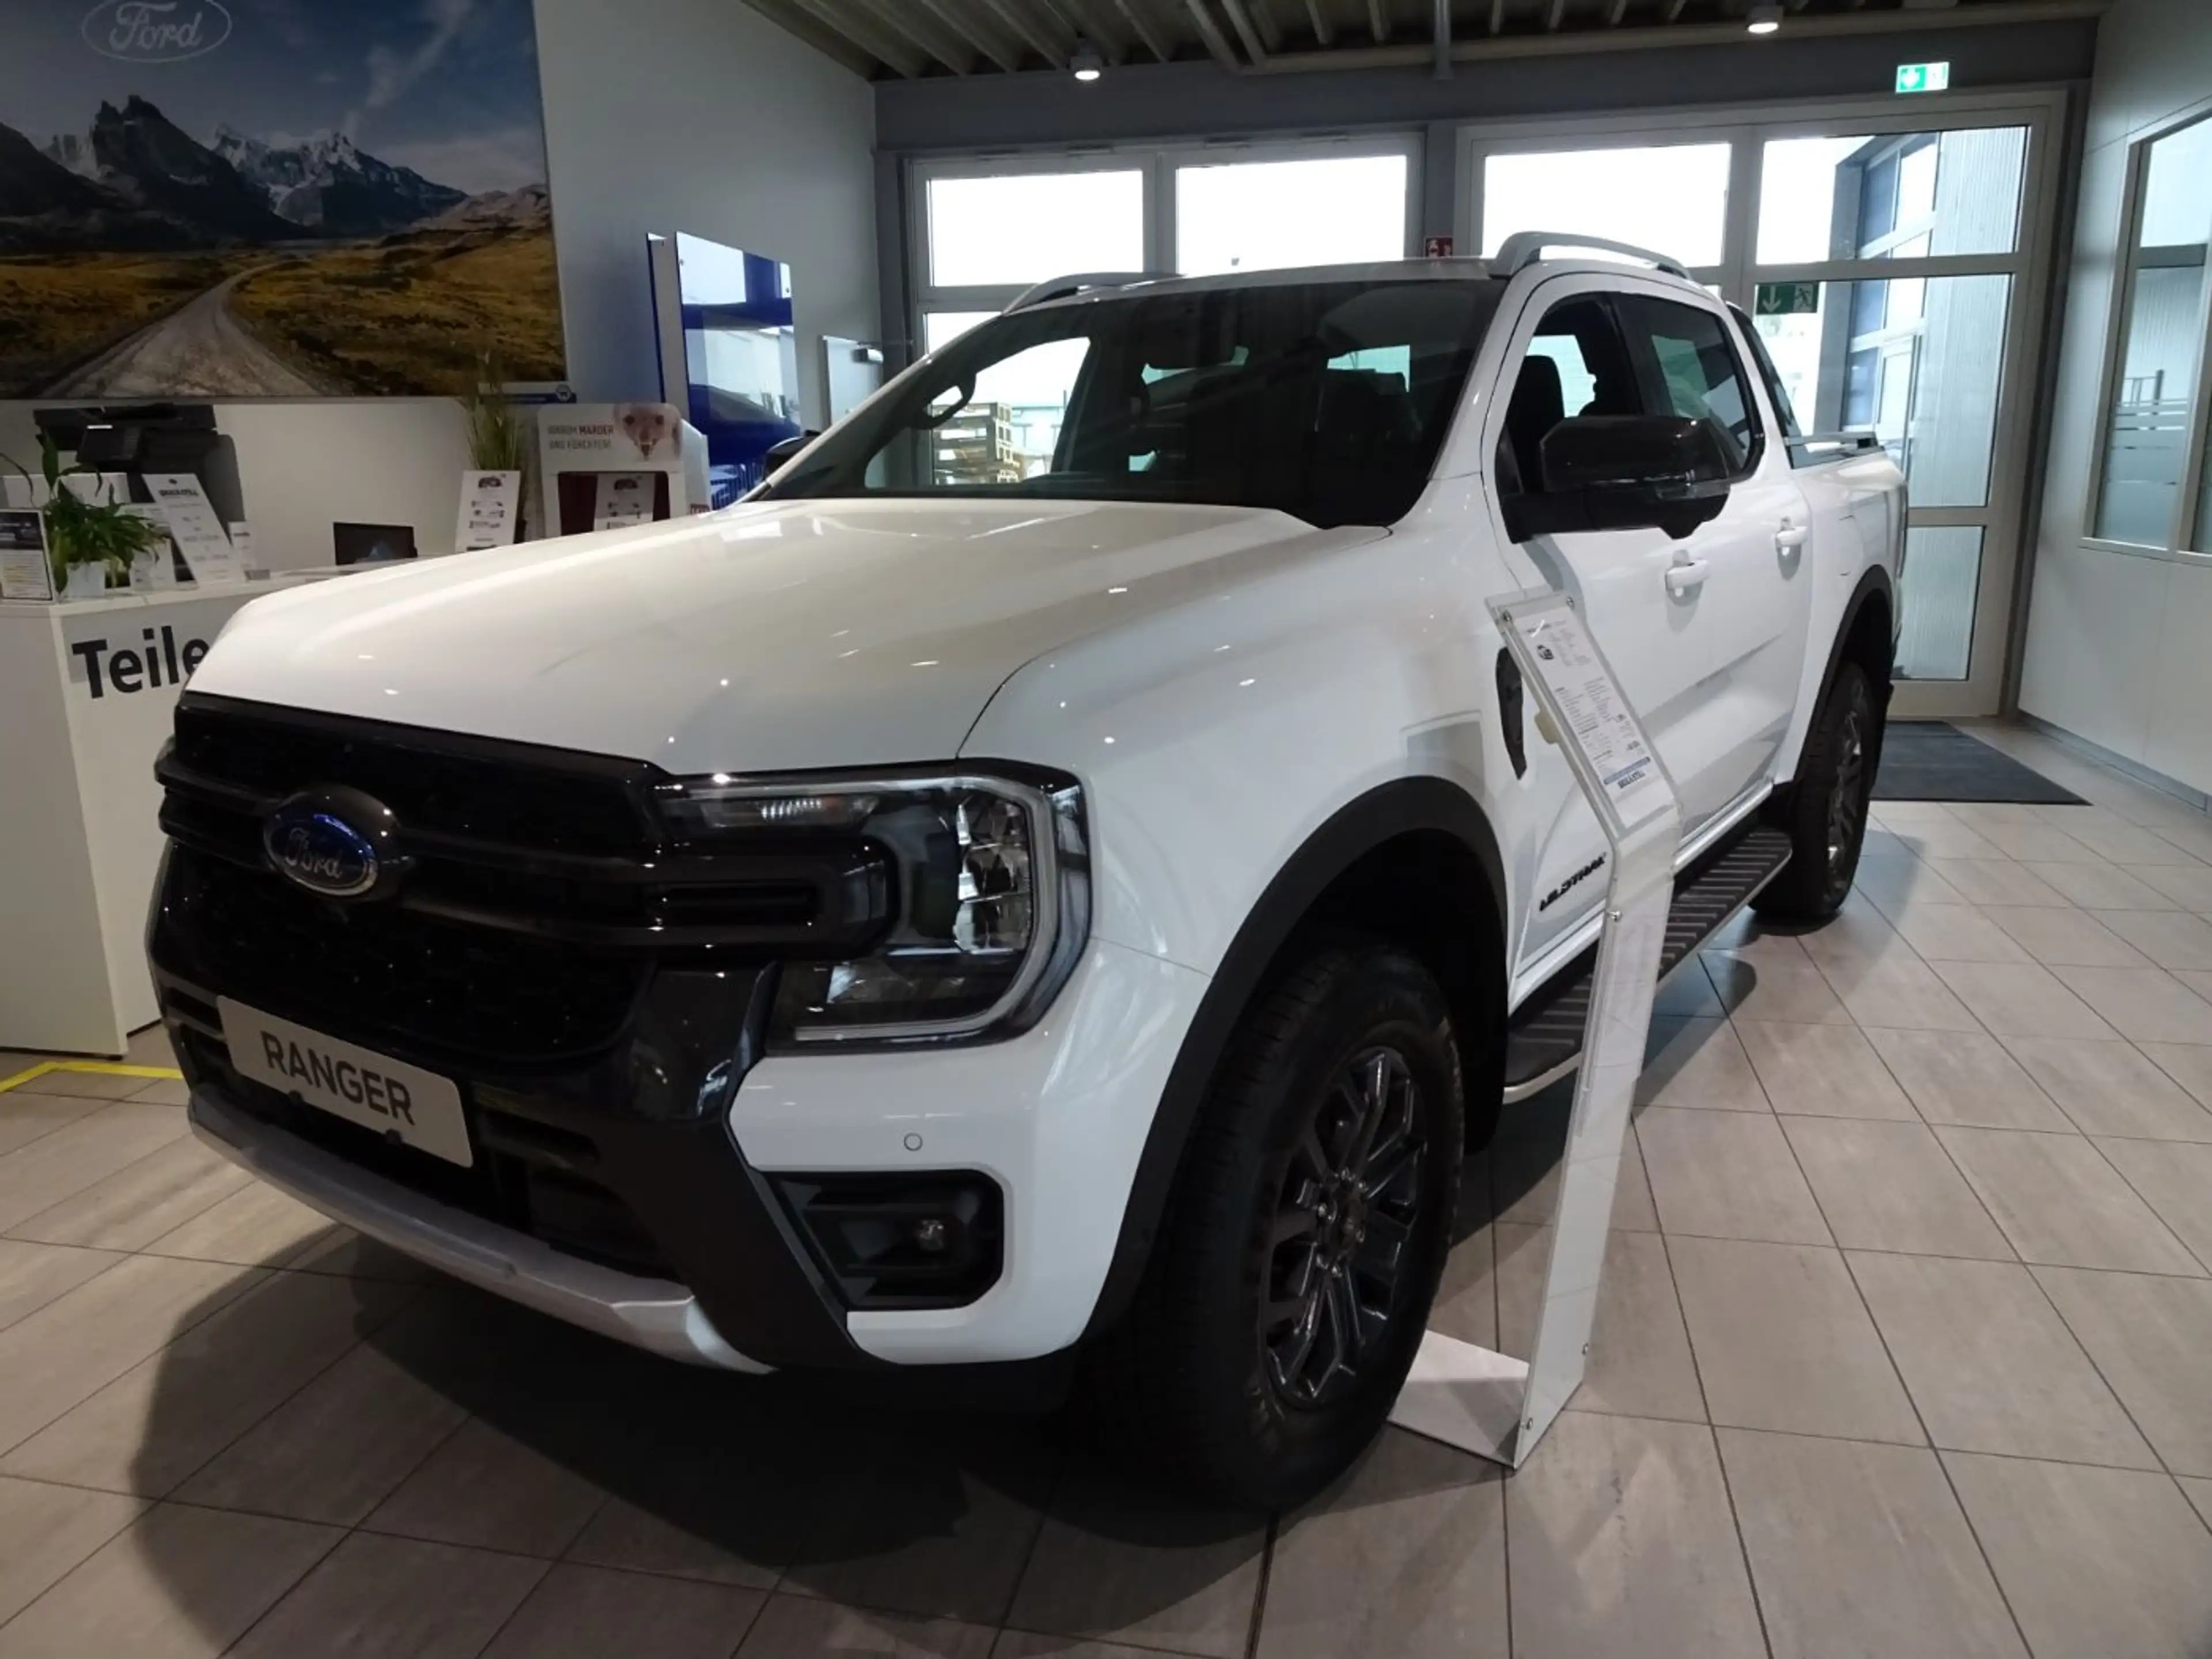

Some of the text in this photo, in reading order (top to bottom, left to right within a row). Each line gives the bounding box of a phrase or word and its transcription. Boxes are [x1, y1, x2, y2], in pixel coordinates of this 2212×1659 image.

[108, 2, 202, 51] Ford
[578, 425, 613, 435] MARDER
[71, 626, 210, 699] Teile
[285, 827, 343, 879] Ford
[260, 1030, 416, 1126] RANGER
